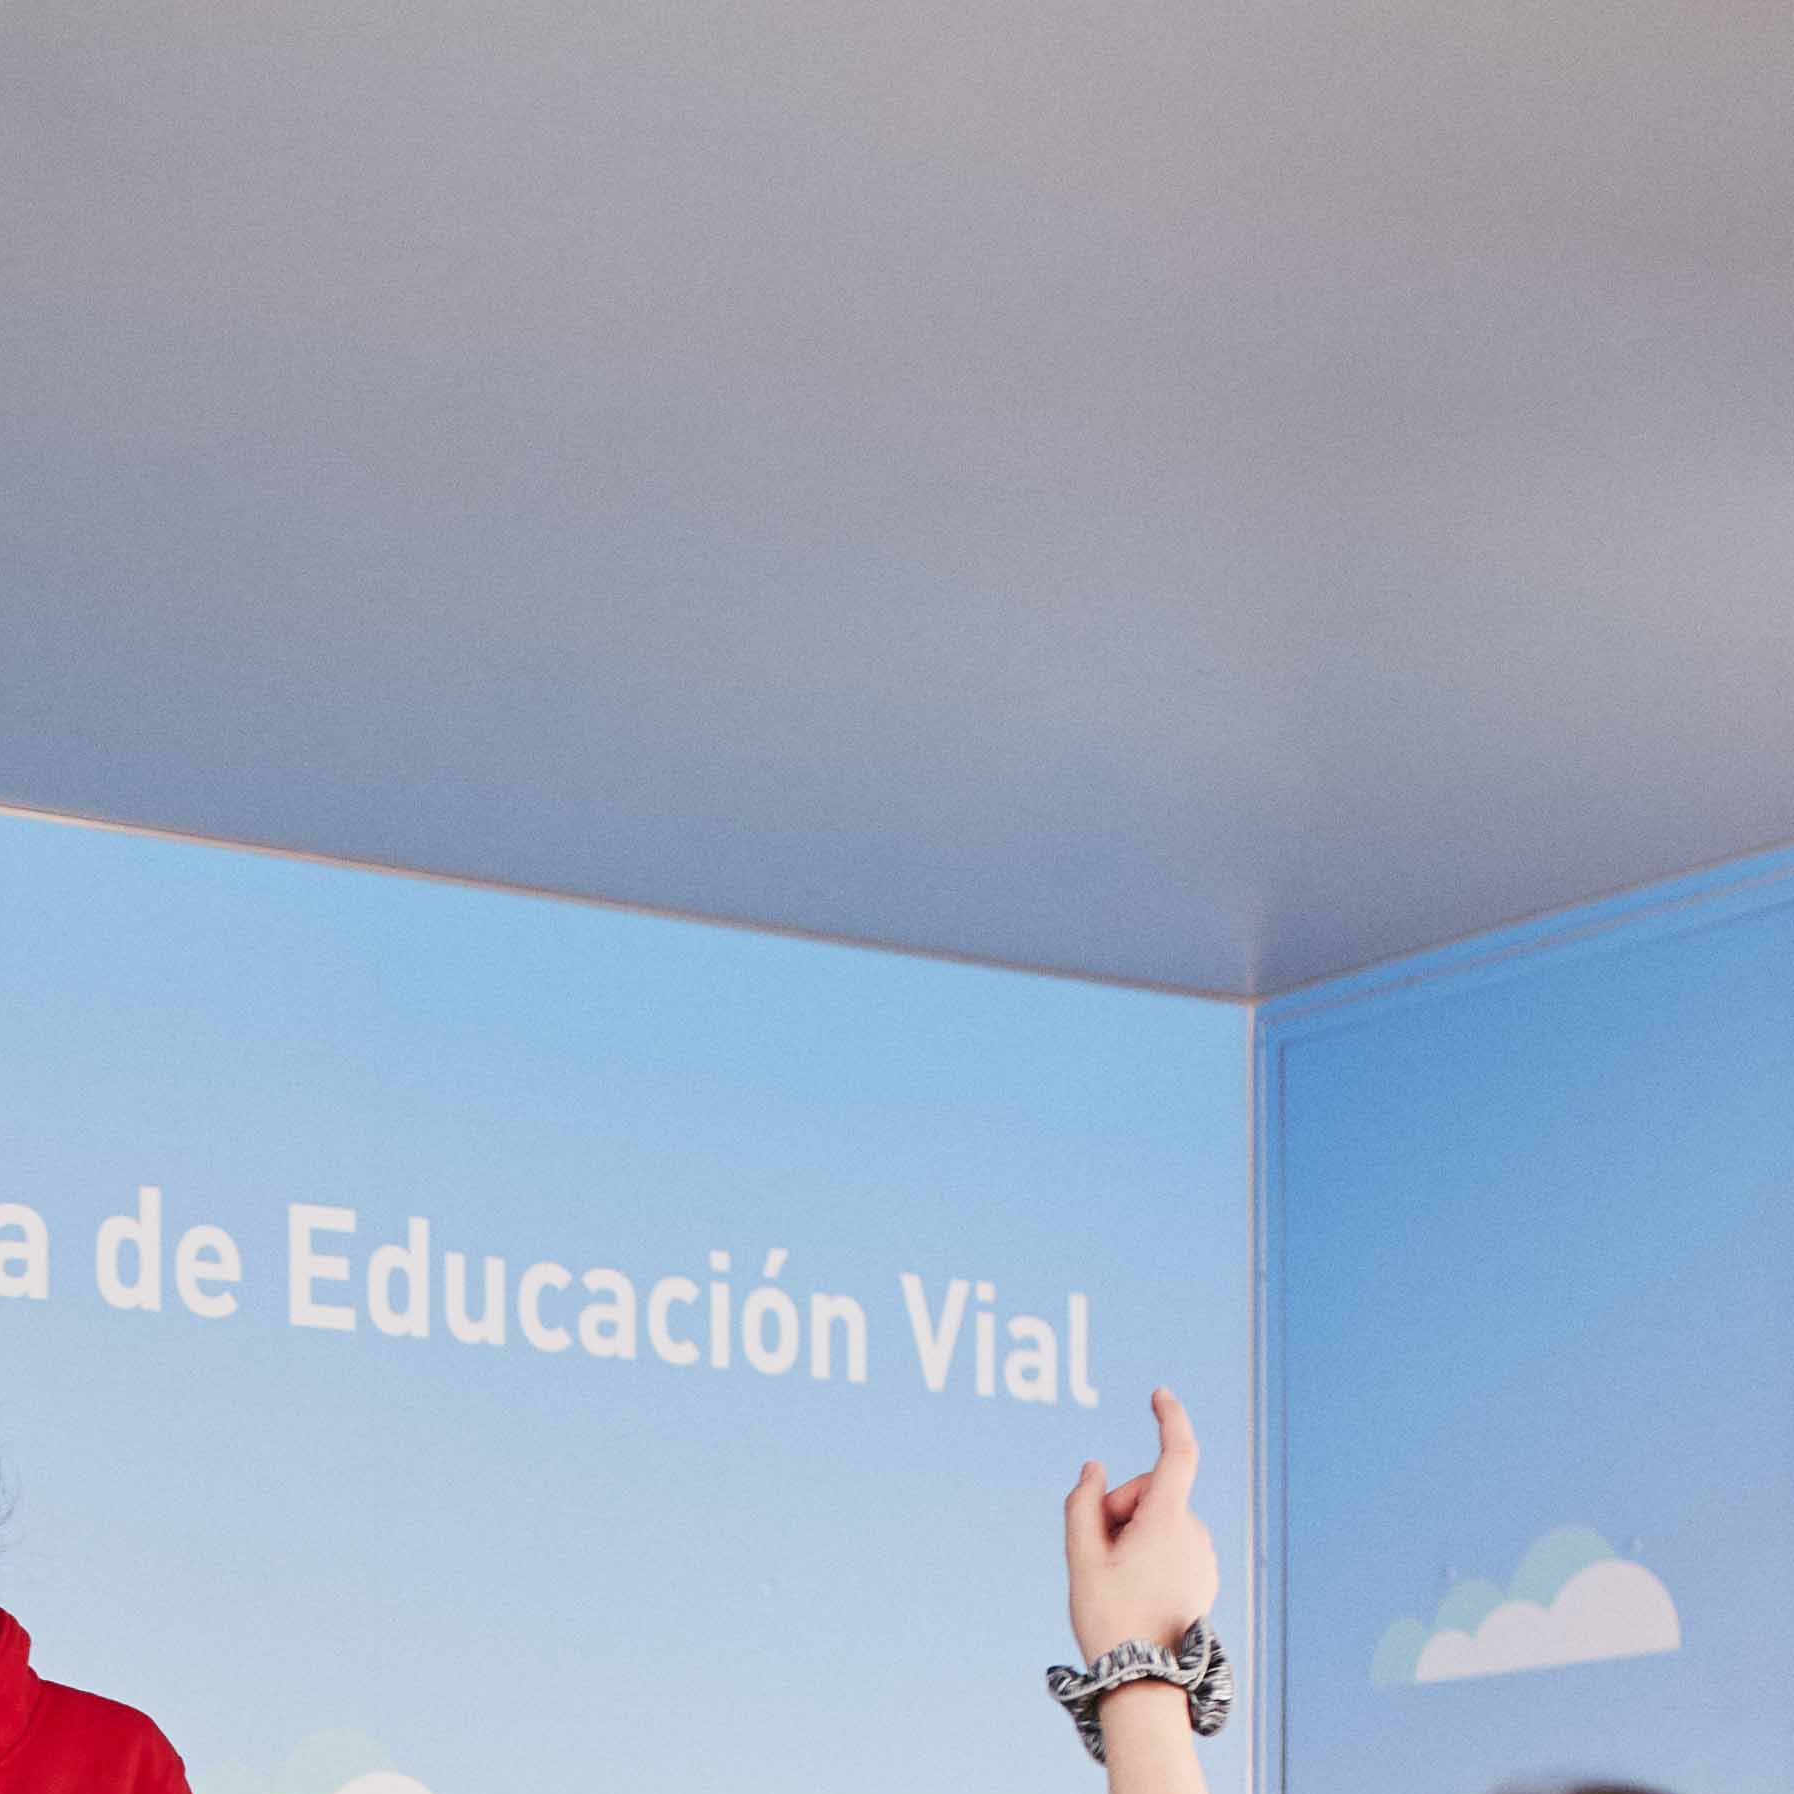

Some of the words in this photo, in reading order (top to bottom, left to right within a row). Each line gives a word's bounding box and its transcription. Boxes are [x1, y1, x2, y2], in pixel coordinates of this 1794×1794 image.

[95, 1186, 243, 1318] de
[287, 1202, 868, 1384] Educación
[900, 1273, 1102, 1408] Vial
